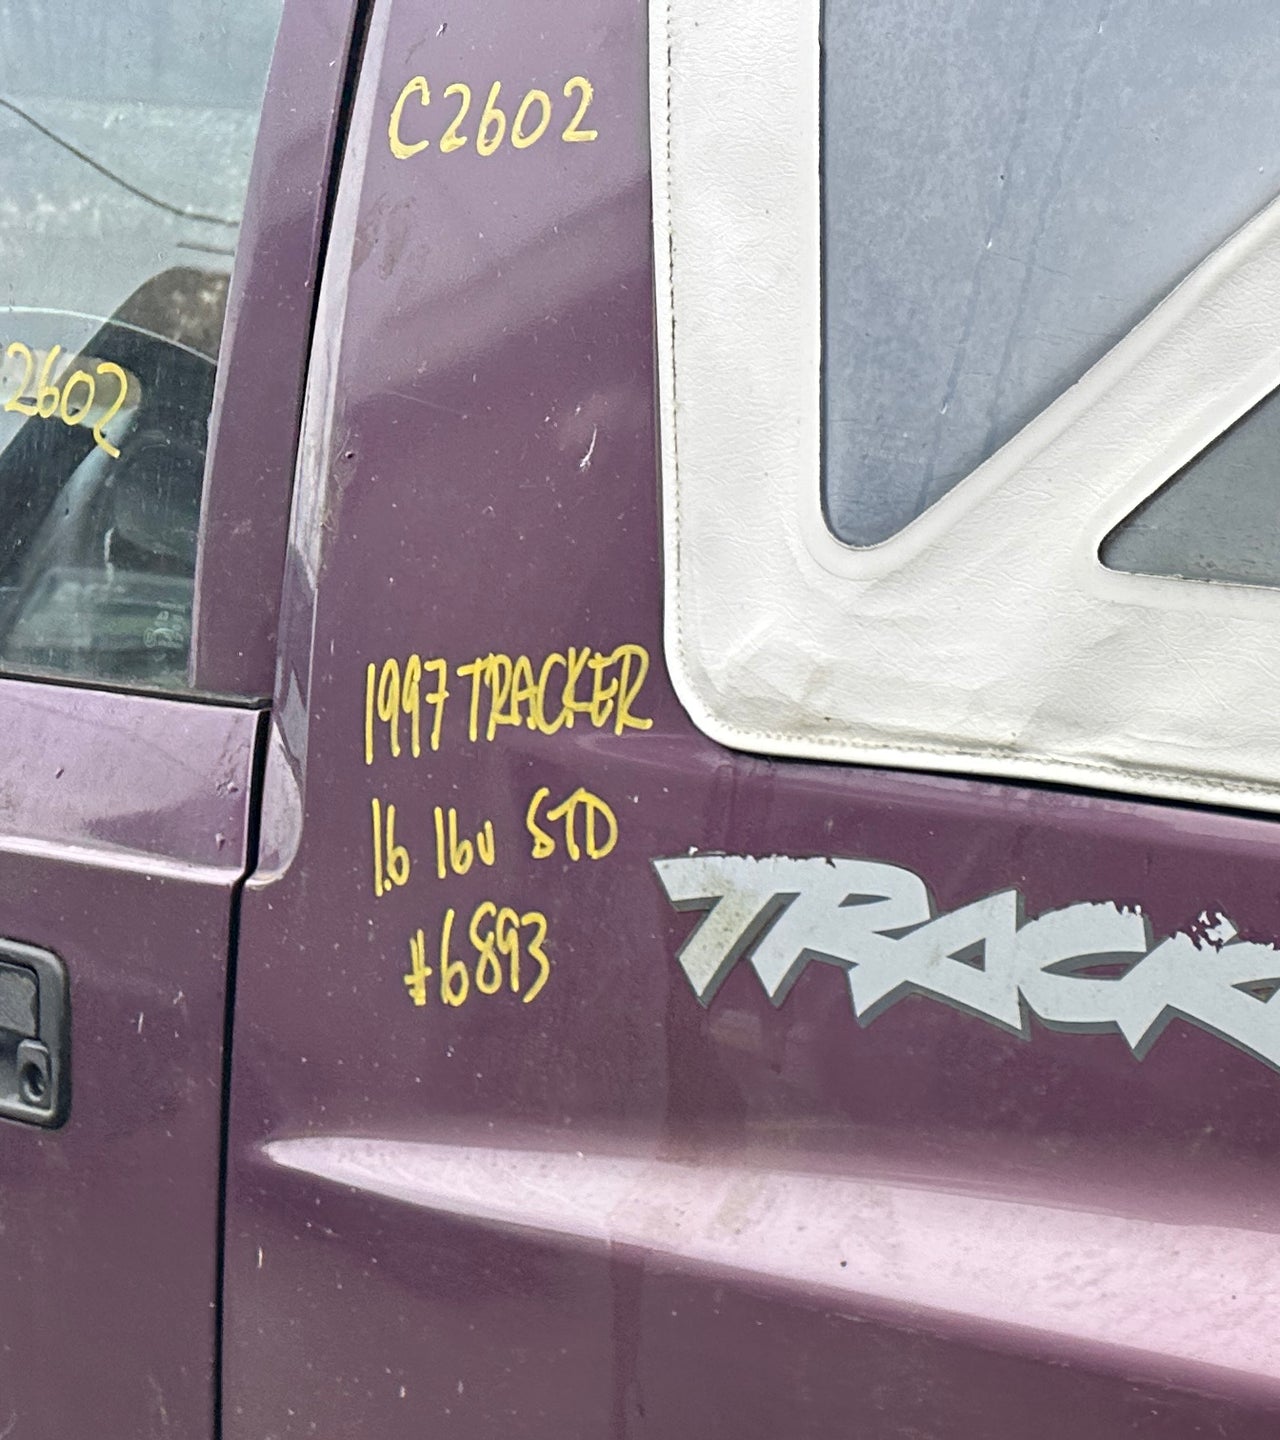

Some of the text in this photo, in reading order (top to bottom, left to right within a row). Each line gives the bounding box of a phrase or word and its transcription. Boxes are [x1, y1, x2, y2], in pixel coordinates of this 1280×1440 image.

[388, 77, 599, 159] C2602
[364, 643, 654, 765] 1997 TRACKER
[525, 786, 619, 861] STD
[403, 901, 552, 1007] #6893
